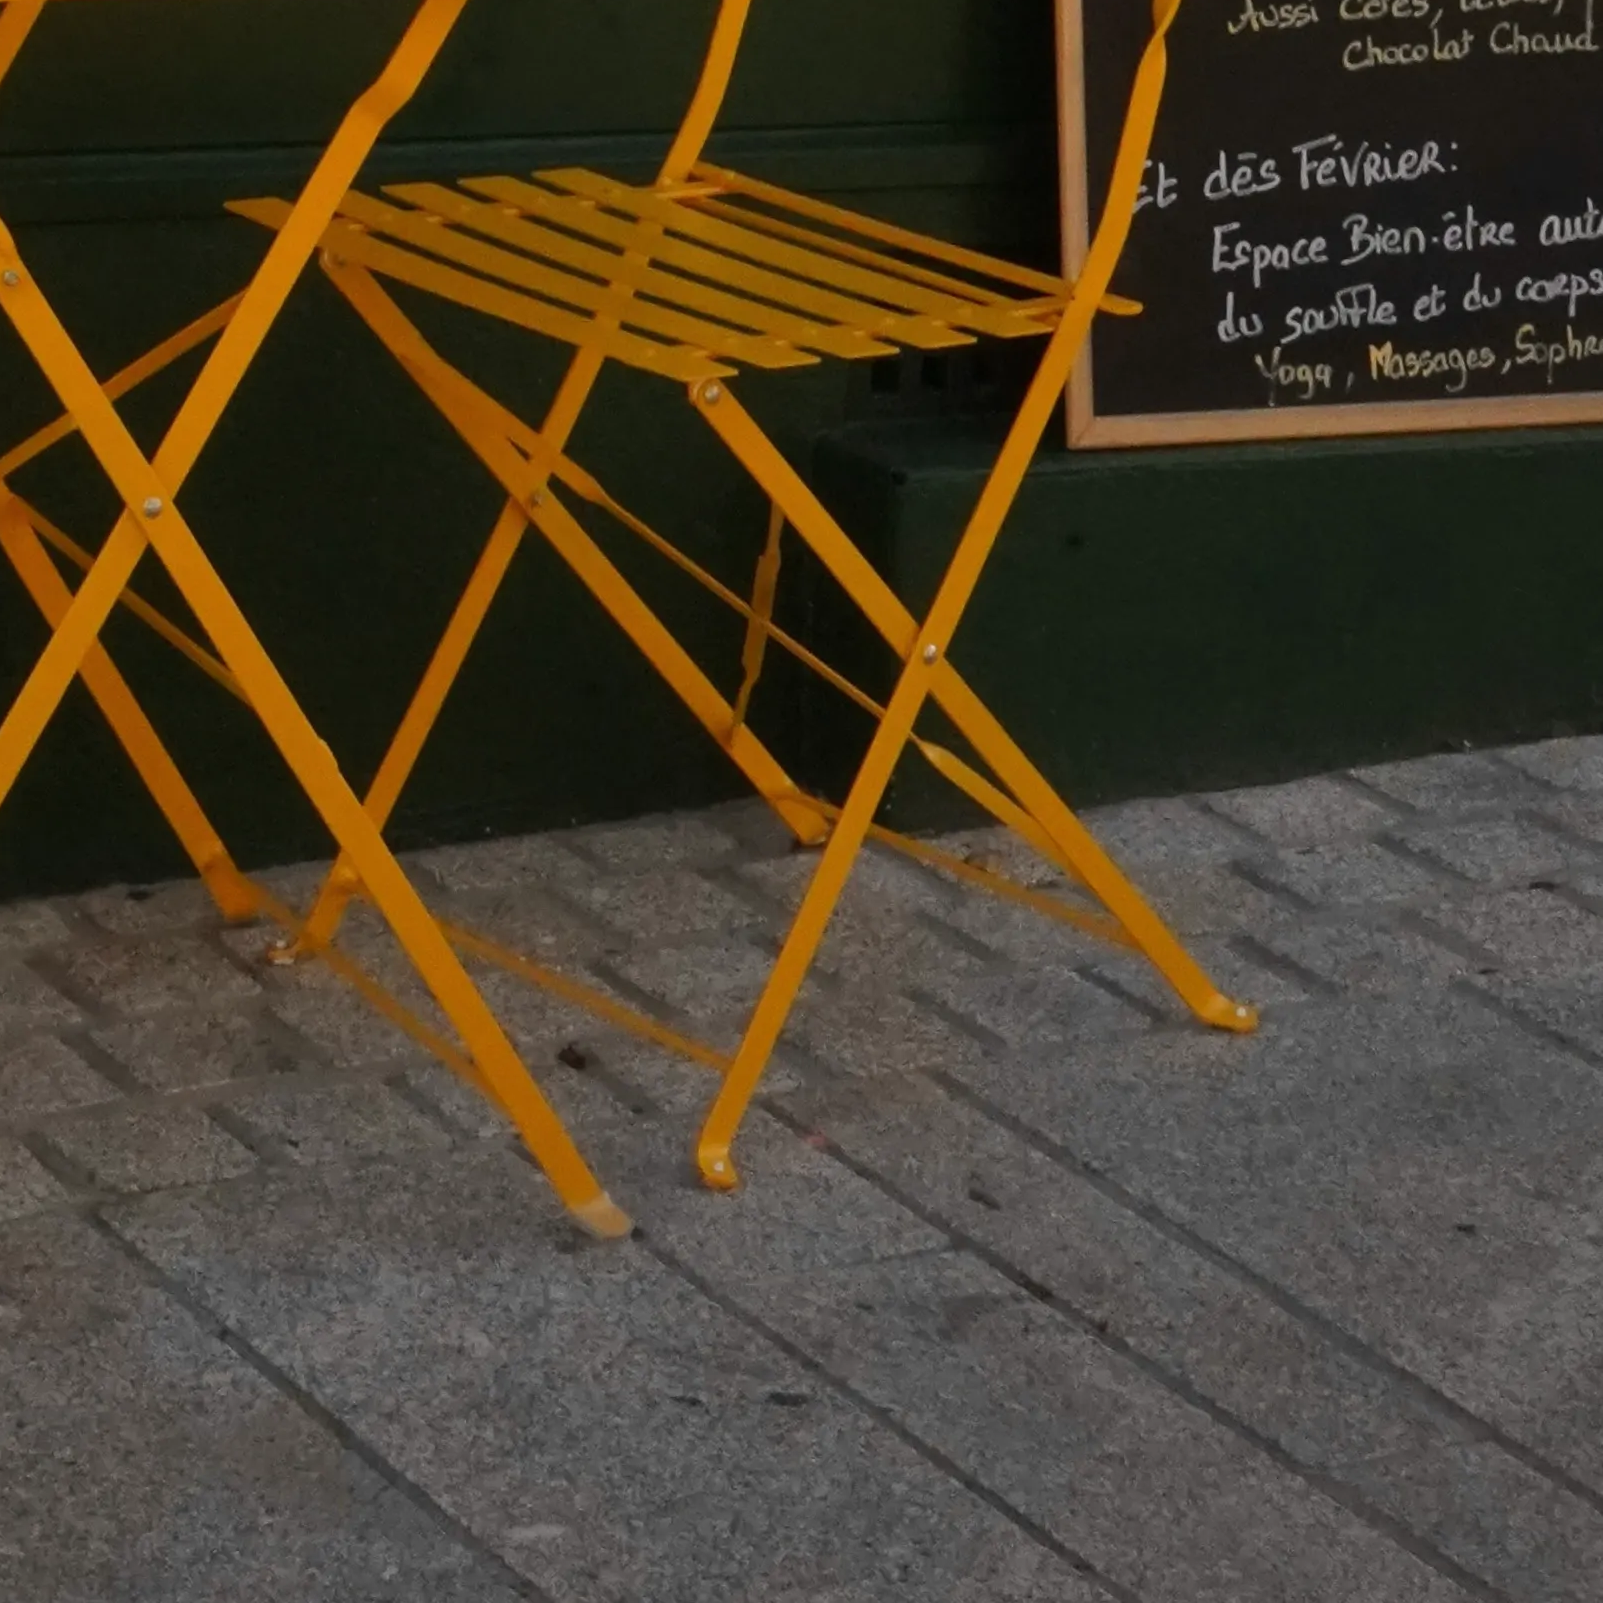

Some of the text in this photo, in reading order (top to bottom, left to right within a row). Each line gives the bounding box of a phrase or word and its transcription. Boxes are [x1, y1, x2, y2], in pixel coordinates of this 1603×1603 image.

[1211, 221, 1330, 288] Espace
[1217, 291, 1265, 344] du
[1280, 282, 1398, 345] souffle
[1413, 283, 1447, 322] et
[1462, 271, 1502, 311] du
